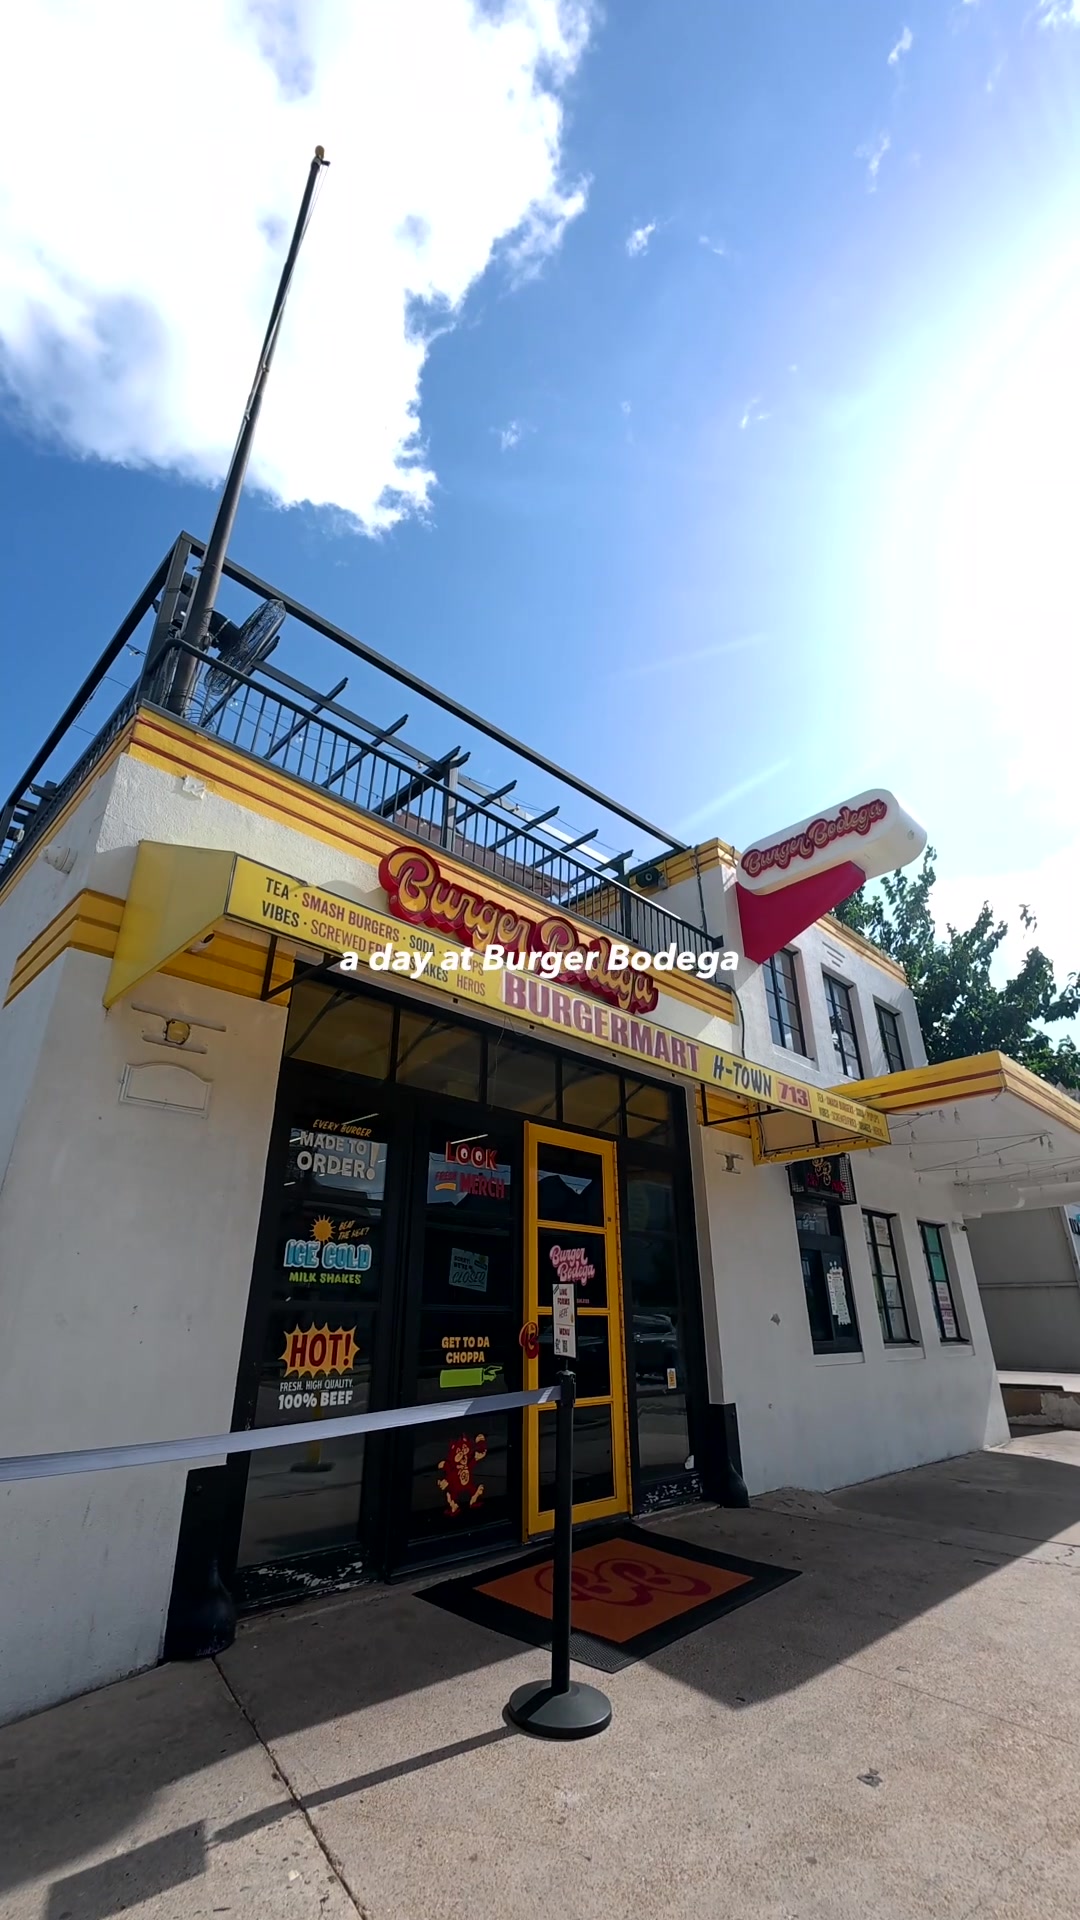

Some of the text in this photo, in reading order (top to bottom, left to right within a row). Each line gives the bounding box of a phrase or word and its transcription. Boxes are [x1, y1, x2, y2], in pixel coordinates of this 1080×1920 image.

[743, 799, 886, 877] Burger Bodega
[266, 876, 290, 901] TEA
[302, 891, 345, 922] SMASH
[348, 909, 400, 943] BURGERS
[409, 934, 436, 957] SODA
[261, 900, 486, 997] VIBES SCREWED FRIS SAKES HEROS
[503, 970, 700, 1073] BURGERMART
[712, 1055, 809, 1107] H-TOWN 713
[312, 1119, 373, 1138] EVERY BURGER
[300, 1131, 368, 1156] MADE TO
[445, 1141, 498, 1171] LOOK
[460, 1172, 505, 1199] MERCH
[337, 1230, 352, 1241] THE
[284, 1239, 372, 1271] ICE COLD
[549, 1244, 589, 1266] Burger
[289, 1271, 362, 1285] MILK SHAKES
[557, 1261, 596, 1287] Bodega
[289, 1333, 351, 1368] HOT!
[441, 1336, 490, 1349] GET TO DA
[446, 1351, 485, 1364] CHOPPA
[305, 1379, 323, 1390] HIGH
[278, 1390, 353, 1410] 100% BEEF
